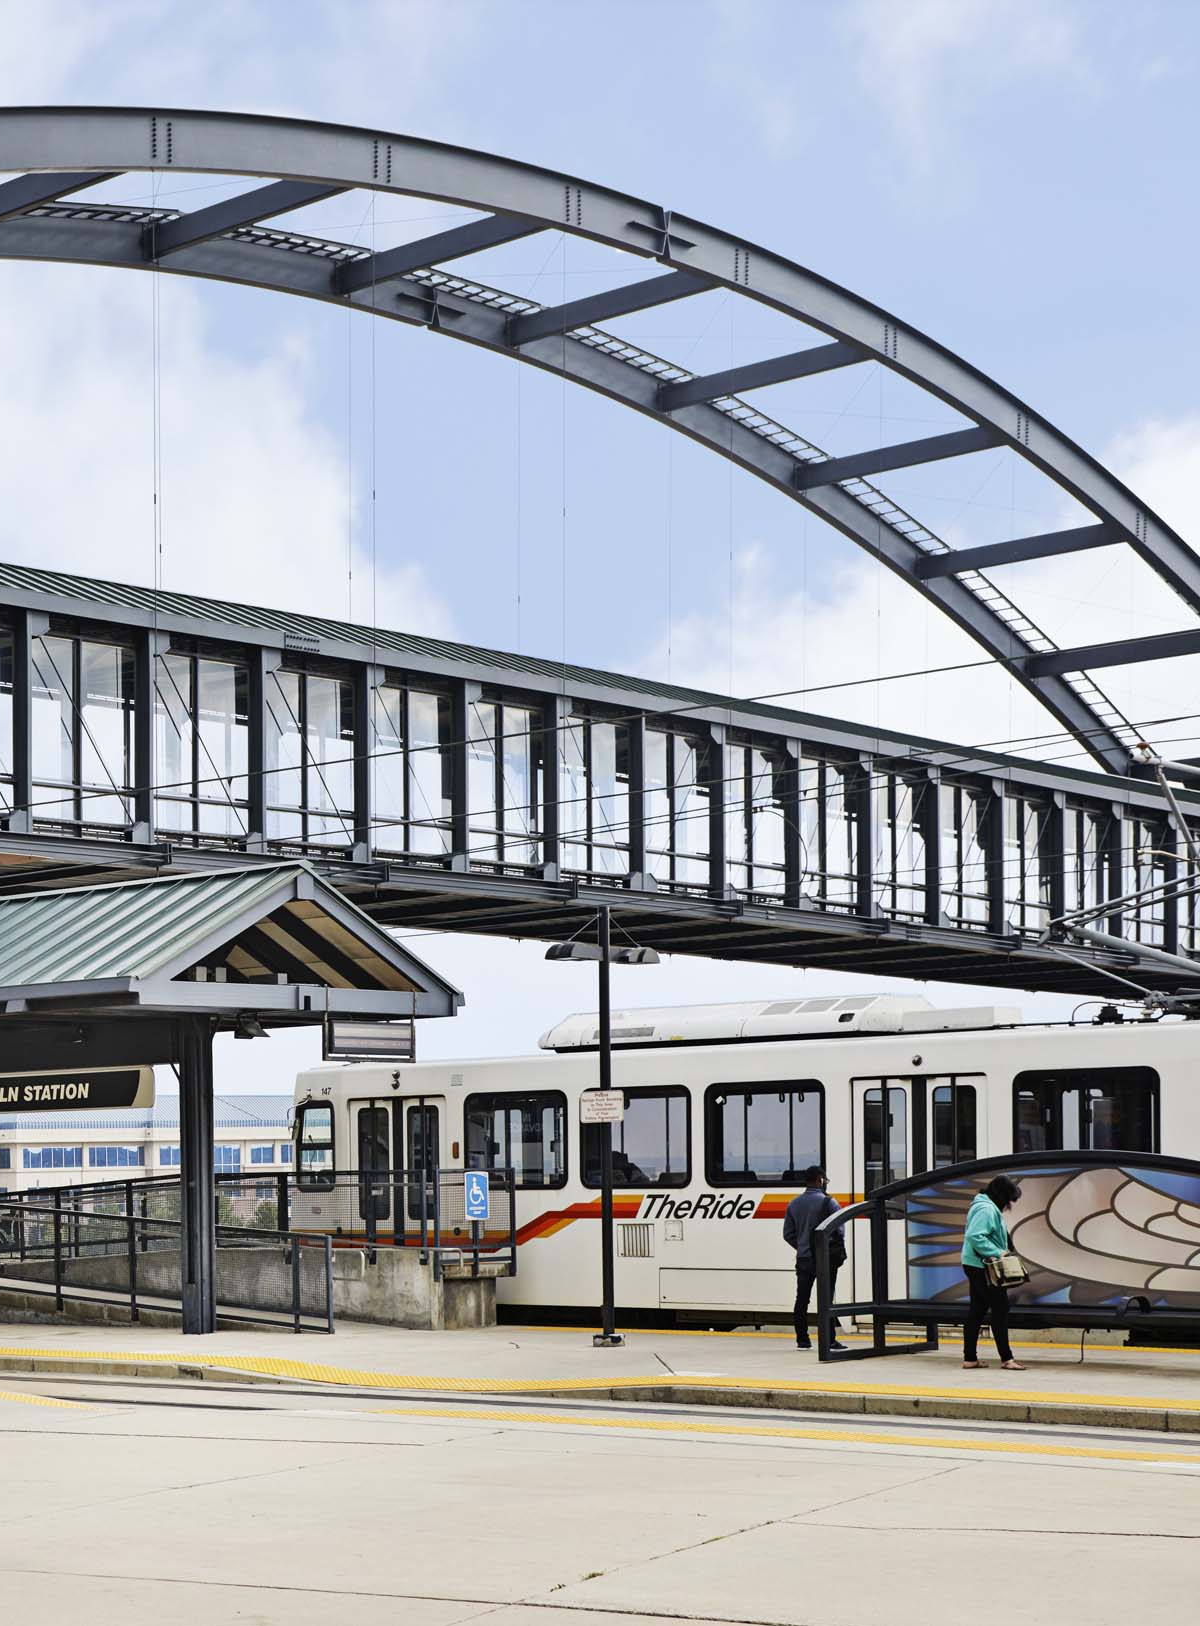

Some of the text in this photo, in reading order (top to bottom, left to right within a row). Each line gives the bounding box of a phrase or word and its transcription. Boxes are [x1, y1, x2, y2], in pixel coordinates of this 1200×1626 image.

[23, 1083, 90, 1101] STATION
[321, 1087, 332, 1096] 147
[643, 1193, 755, 1219] TheRide
